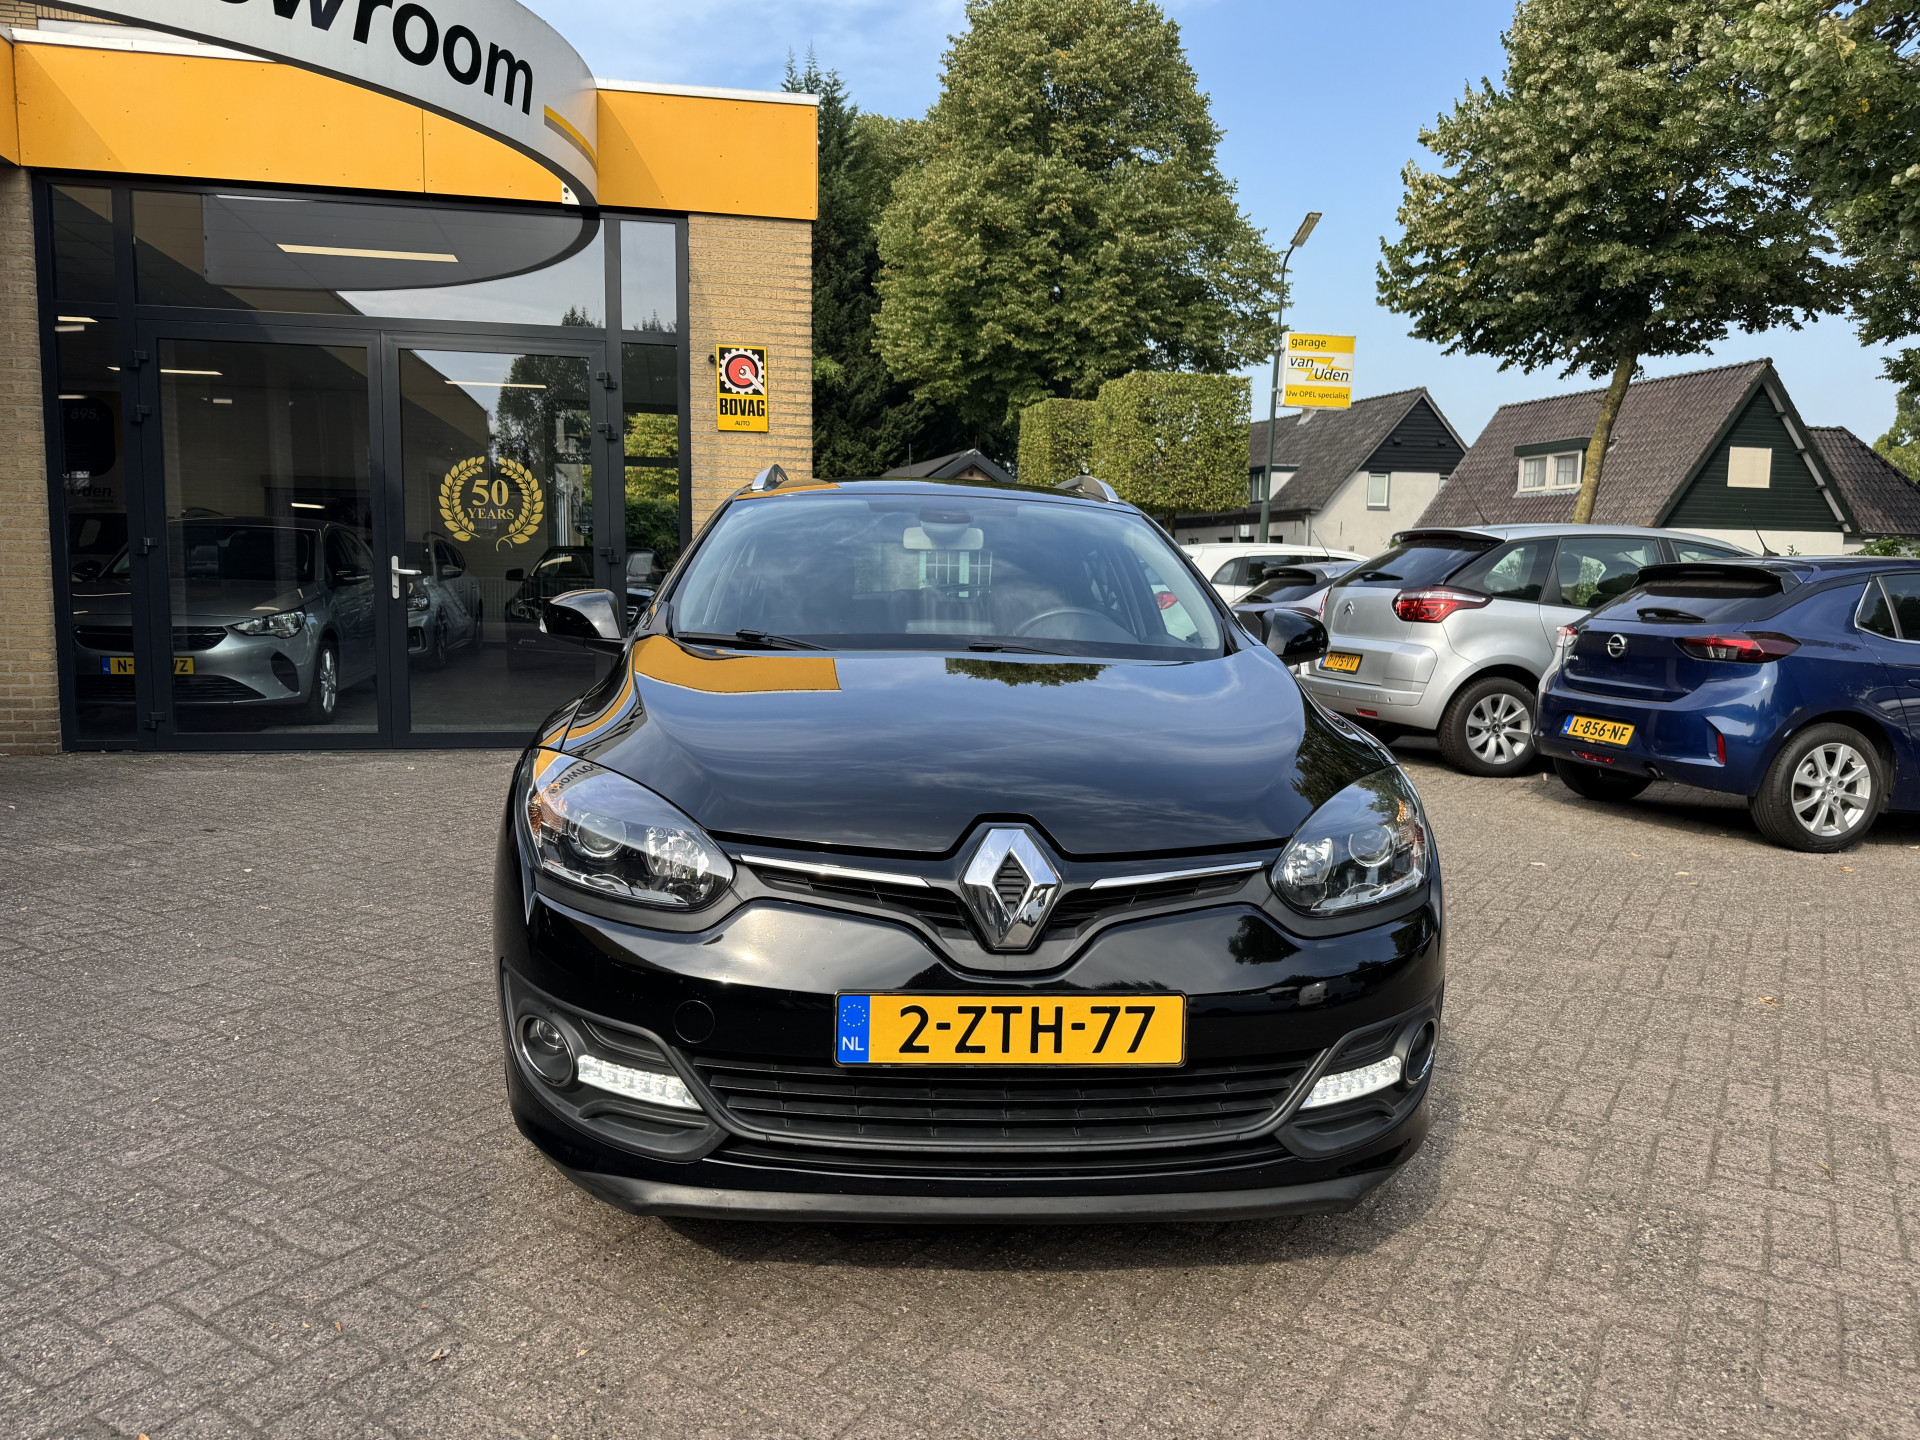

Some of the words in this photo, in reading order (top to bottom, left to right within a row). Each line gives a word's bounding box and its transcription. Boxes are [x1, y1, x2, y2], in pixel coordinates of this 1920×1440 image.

[1291, 338, 1327, 349] garage
[1290, 357, 1314, 368] van
[1314, 368, 1349, 381] Uden
[1299, 390, 1316, 398] OPEL
[1317, 391, 1349, 399] specialist
[719, 398, 765, 417] BOVAG
[471, 479, 509, 506] 50
[467, 507, 515, 520] YEARS
[1572, 719, 1629, 740] L-856-NF
[899, 1005, 1156, 1053] 2-ZTH-77
[842, 1037, 864, 1051] NL
